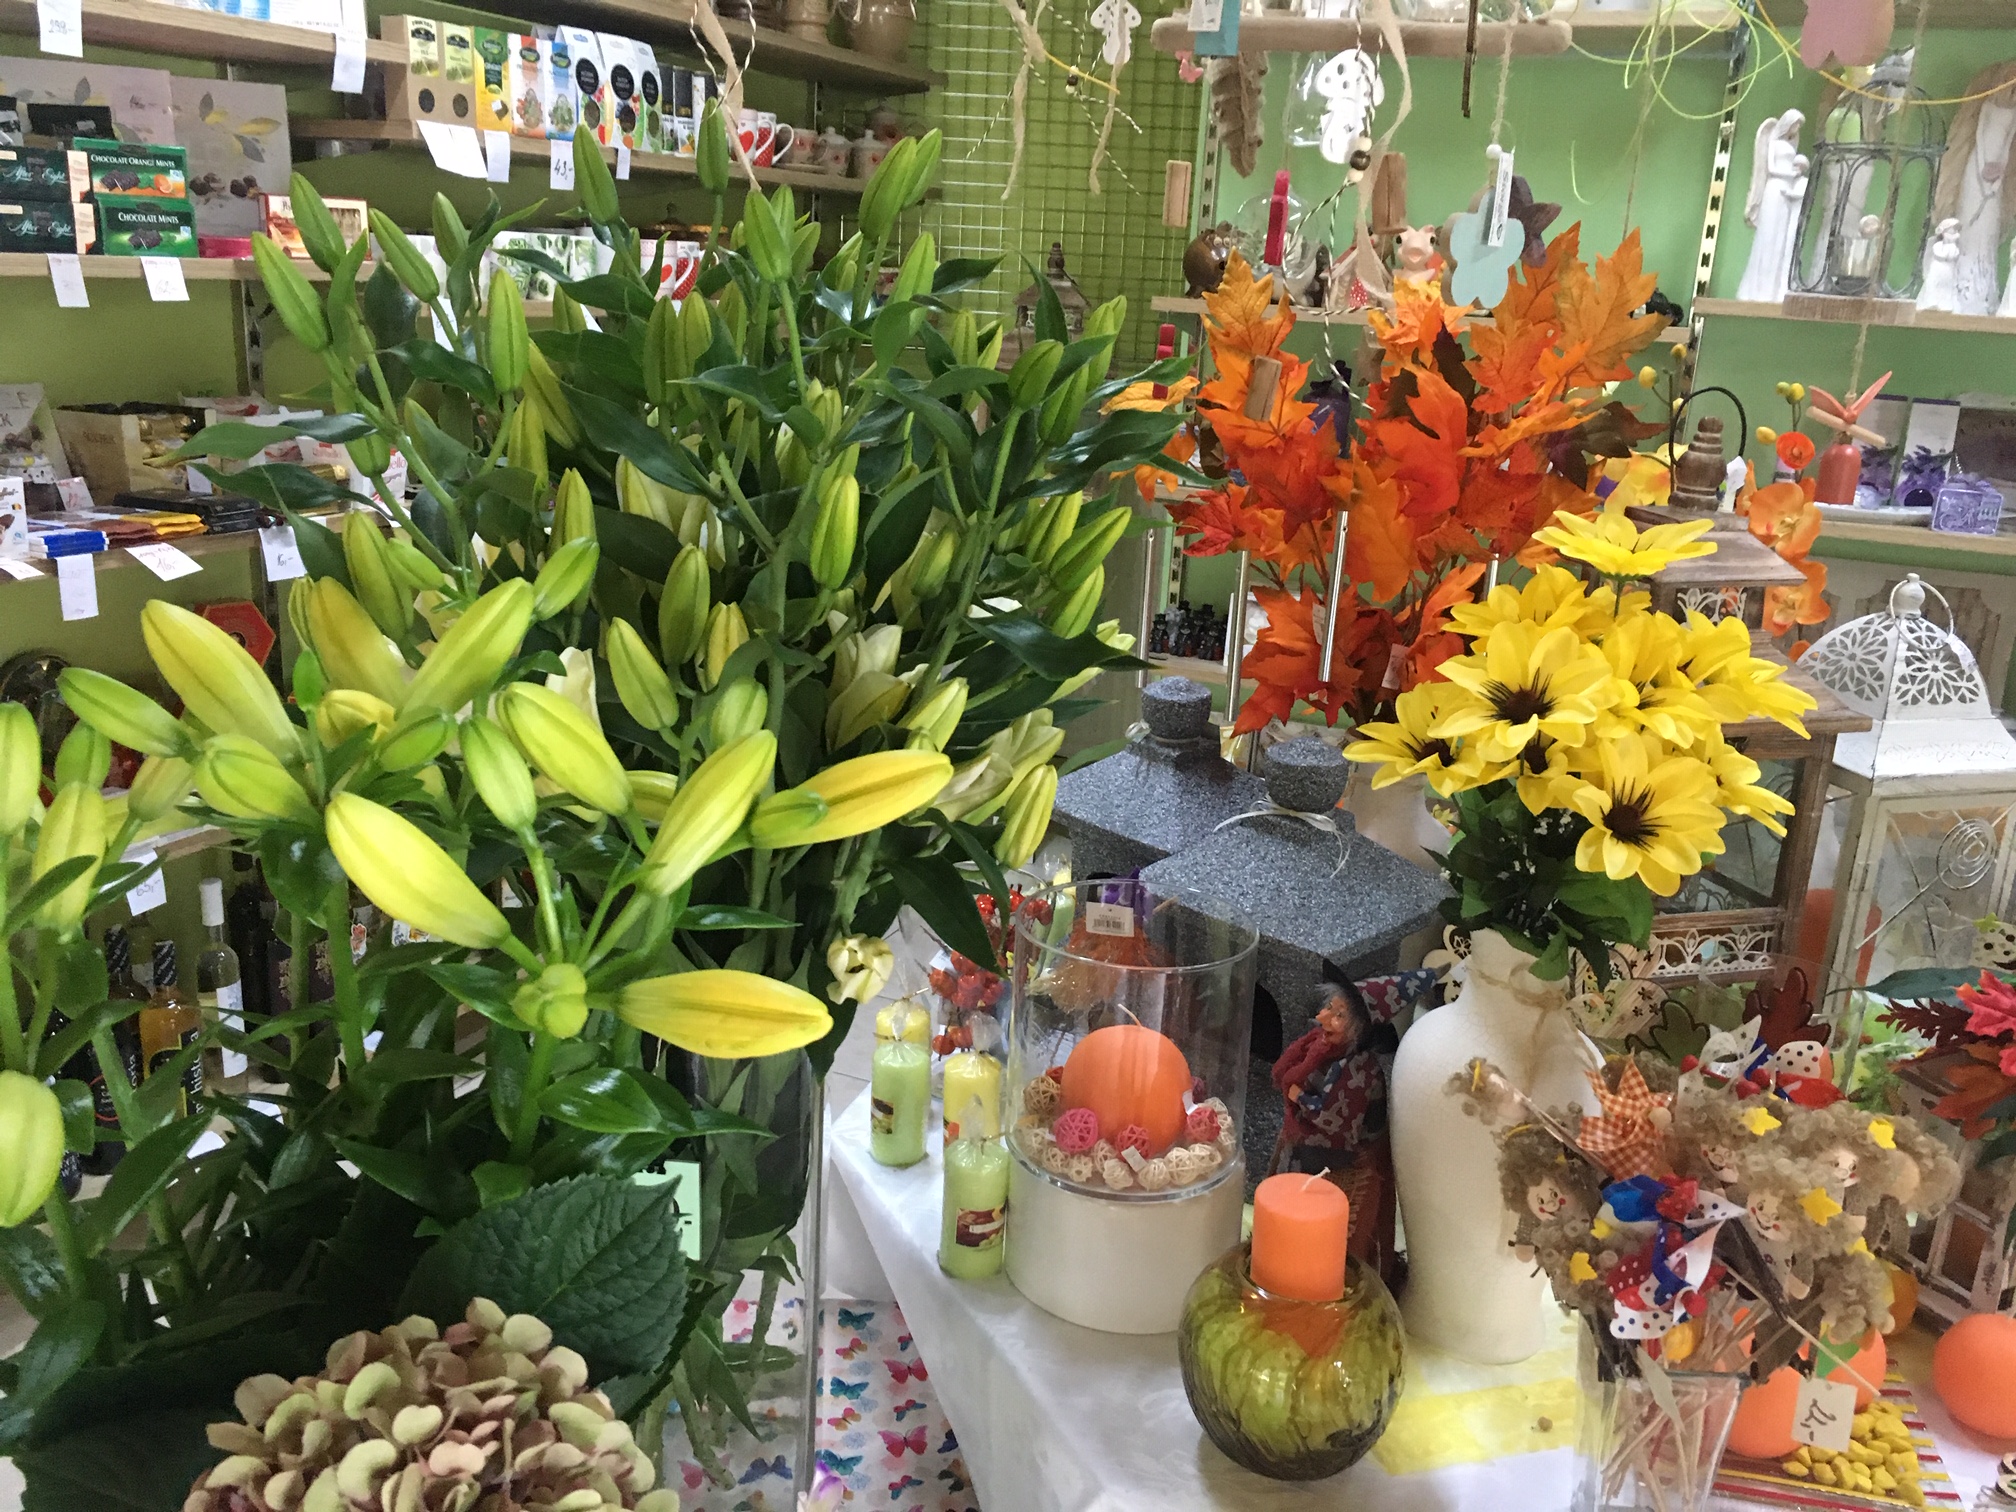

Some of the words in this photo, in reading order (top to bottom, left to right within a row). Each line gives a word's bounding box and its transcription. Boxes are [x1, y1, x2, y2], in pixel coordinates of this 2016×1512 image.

[90, 153, 128, 165] CHOCOLATE
[128, 156, 155, 167] ORANGE
[155, 159, 176, 168] MINTS
[117, 211, 158, 223] CHOCOLATE
[158, 214, 180, 224] MINTS
